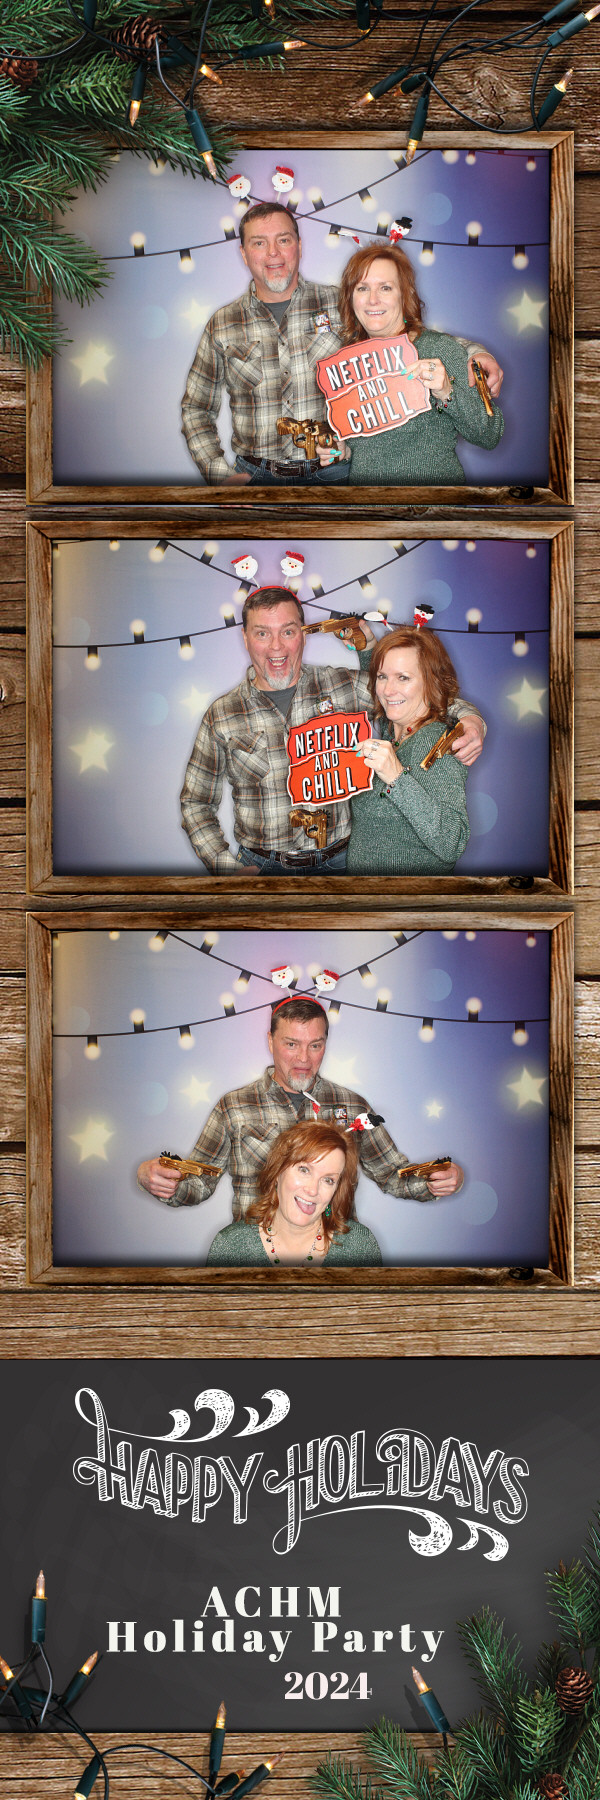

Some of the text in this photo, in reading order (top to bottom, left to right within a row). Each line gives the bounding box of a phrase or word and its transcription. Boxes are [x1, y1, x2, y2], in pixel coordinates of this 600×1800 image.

[325, 345, 406, 391] NETFLIX
[357, 378, 389, 402] AND
[347, 391, 415, 433] CHILL
[295, 722, 360, 758] NETFLIX
[314, 751, 339, 772] AND
[302, 767, 357, 801] CHILL
